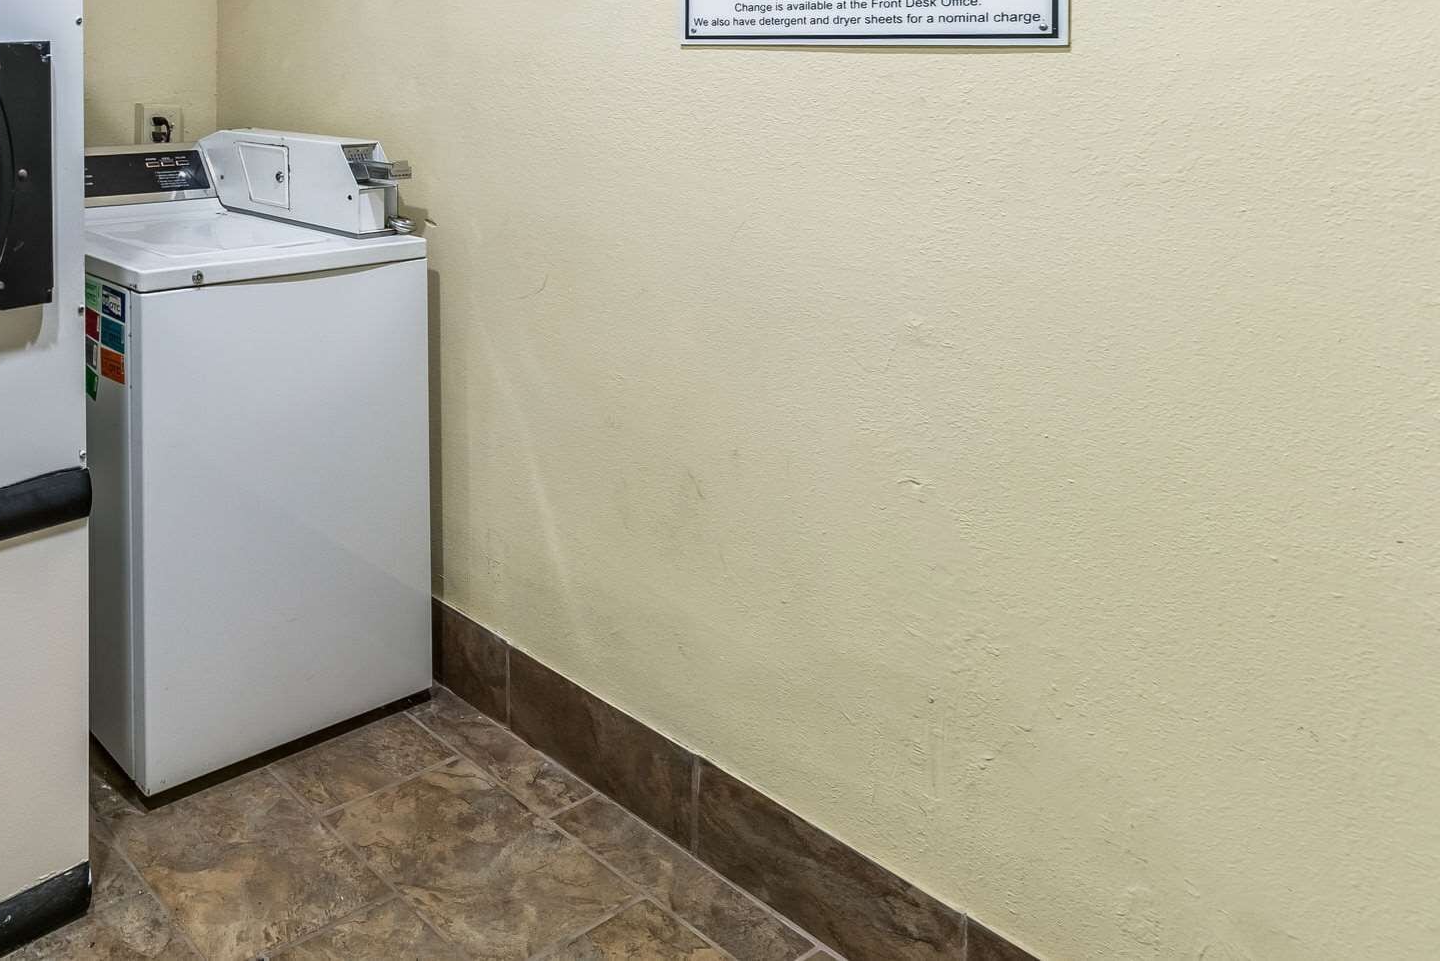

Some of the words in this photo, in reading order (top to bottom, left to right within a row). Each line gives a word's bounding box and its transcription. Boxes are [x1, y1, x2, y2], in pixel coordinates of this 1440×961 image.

[734, 2, 773, 14] Change
[775, 1, 783, 11] is
[786, 0, 833, 11] available
[836, 0, 847, 10] at
[850, 0, 868, 10] the
[693, 17, 709, 27] We
[711, 18, 731, 27] also
[733, 16, 756, 26] have
[759, 16, 807, 28] detergent
[809, 15, 830, 25] and
[832, 15, 862, 27] dryer
[864, 14, 903, 25] sheets
[906, 13, 923, 23] for
[926, 15, 934, 24] a
[938, 12, 989, 23] nominal
[993, 12, 1046, 25] charge.
